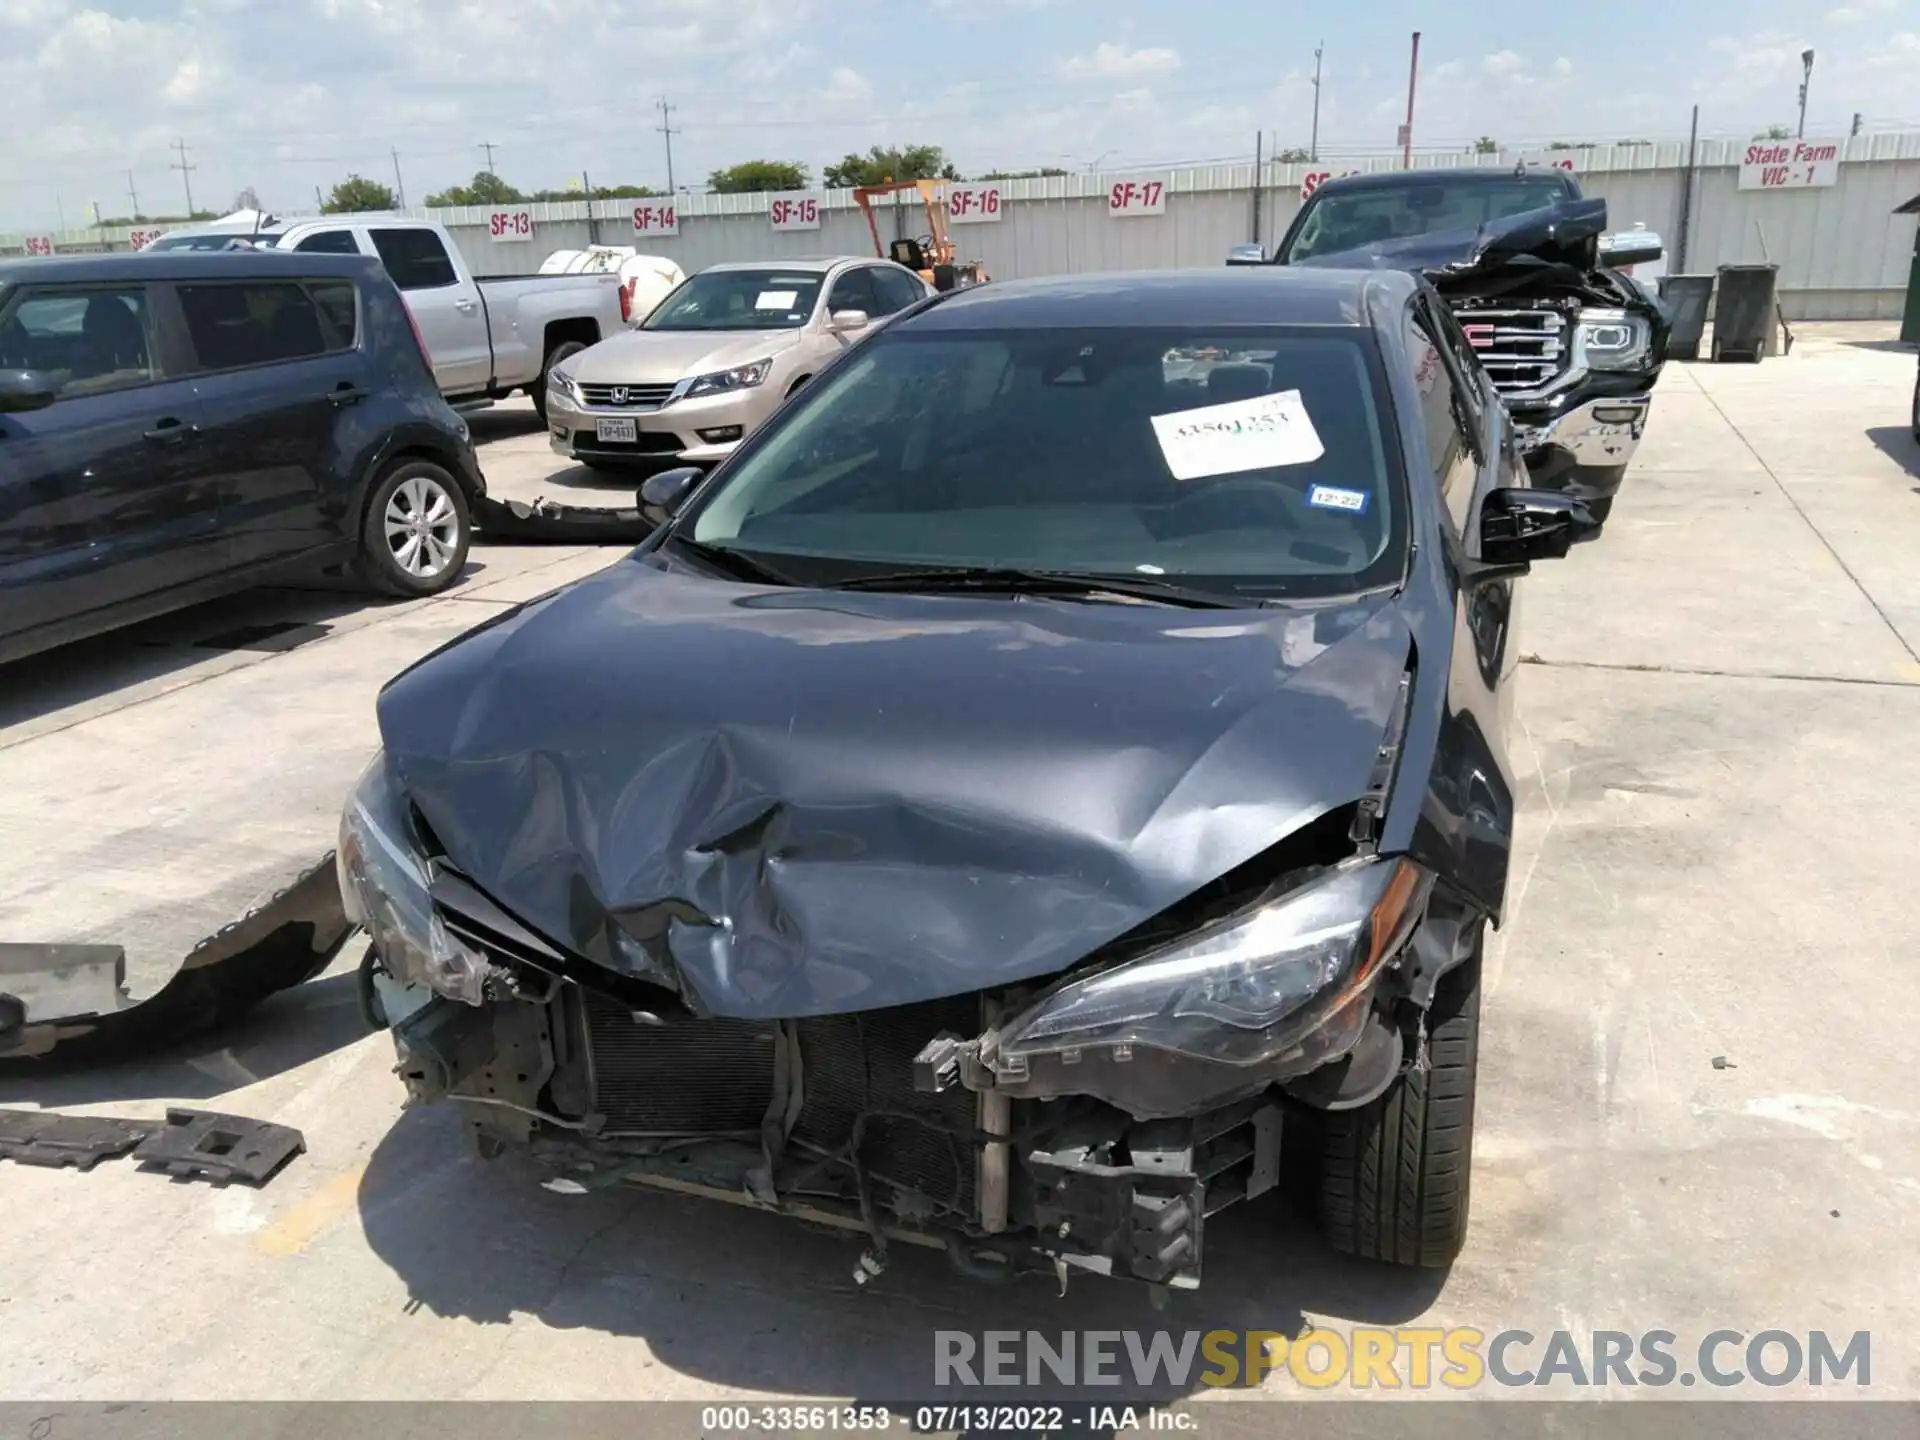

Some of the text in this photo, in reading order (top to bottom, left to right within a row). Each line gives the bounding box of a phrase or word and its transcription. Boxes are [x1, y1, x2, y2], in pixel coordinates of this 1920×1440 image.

[1744, 142, 1837, 165] State Farm
[1761, 166, 1790, 186] VIC
[1806, 165, 1815, 184] 1
[951, 189, 999, 216] SF-16
[1110, 181, 1162, 209] SF-17
[491, 211, 530, 236] SF-13
[634, 206, 676, 230] SF-14
[772, 199, 816, 225] SF-15
